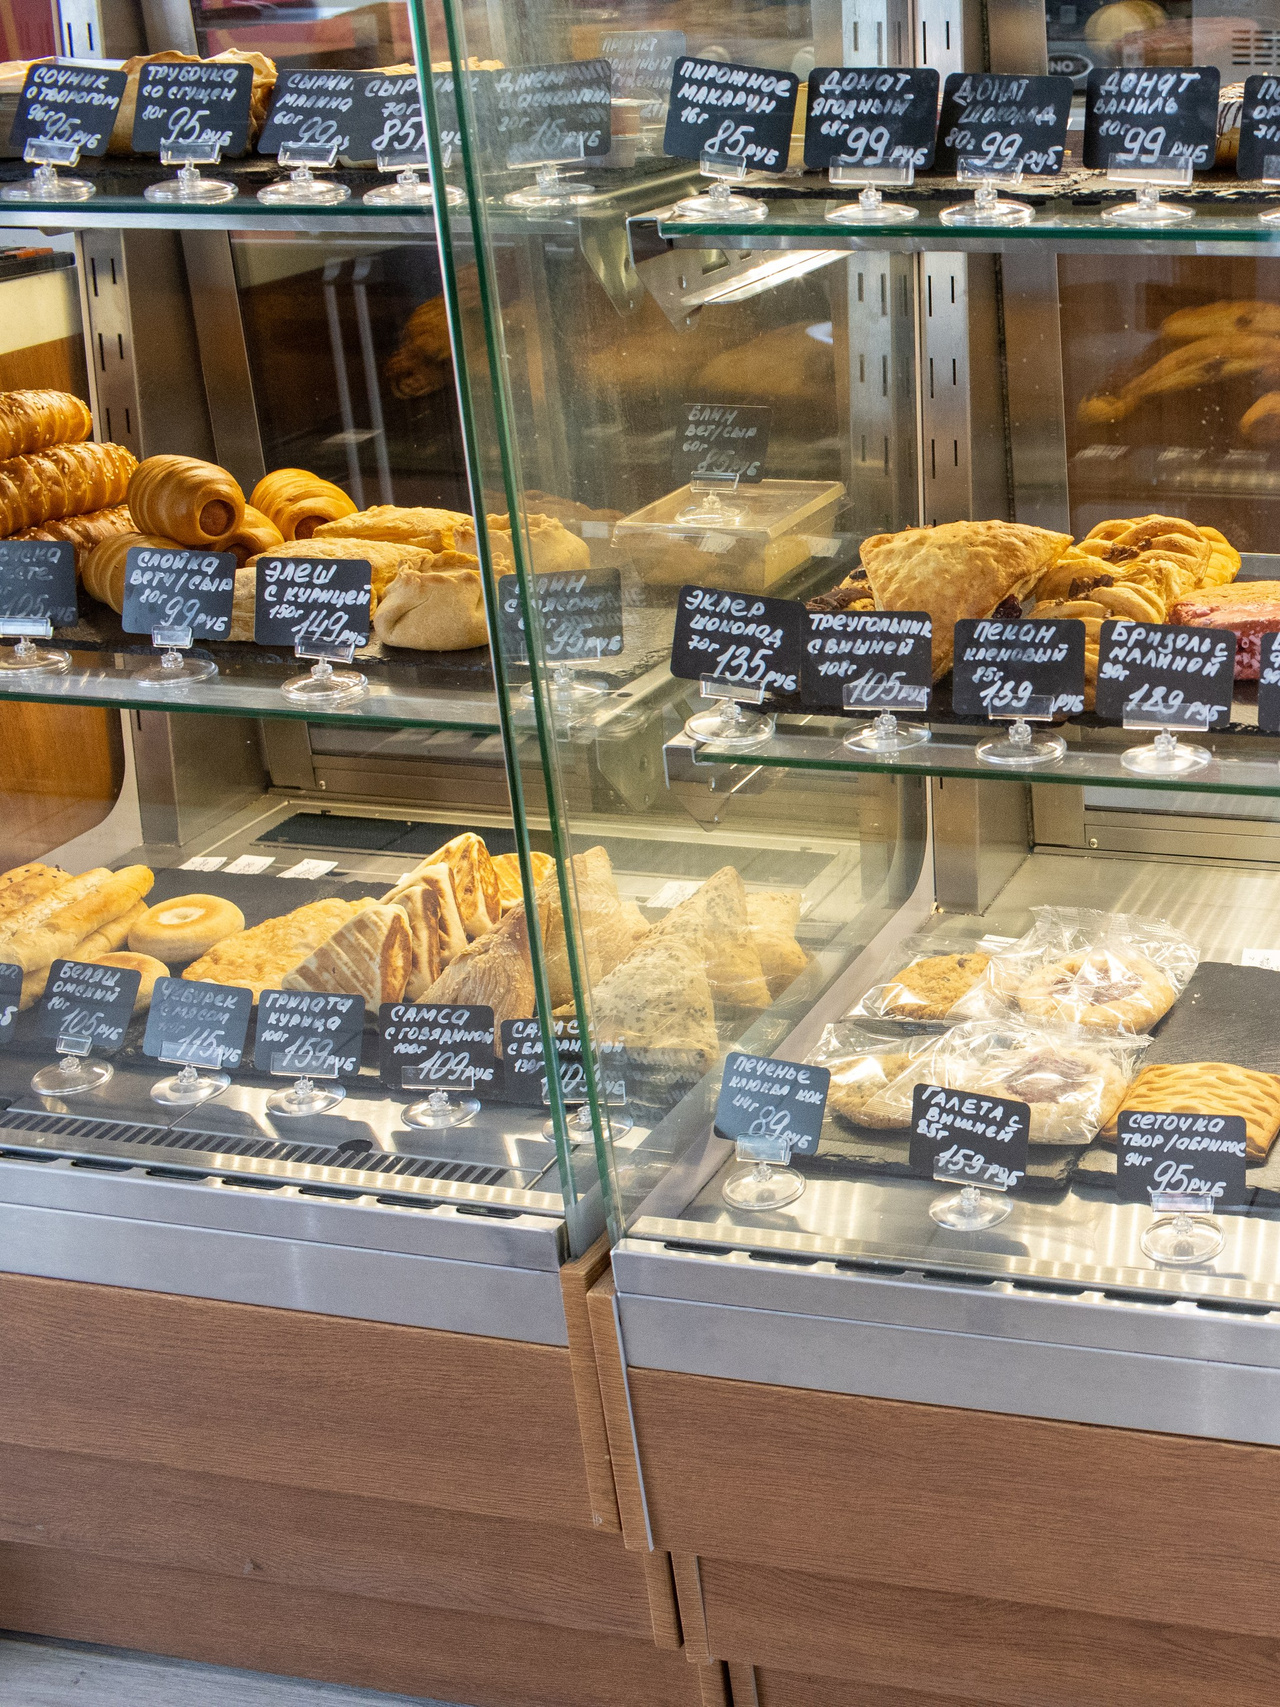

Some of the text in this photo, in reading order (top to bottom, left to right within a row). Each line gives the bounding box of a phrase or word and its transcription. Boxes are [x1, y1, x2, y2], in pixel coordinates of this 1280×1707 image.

[33, 66, 110, 90] СОЧНИК
[148, 65, 240, 83] ТРУБОЧКА
[680, 61, 791, 98] ПИРОЖНОЕ
[820, 70, 911, 95] ДОНАТ
[1099, 71, 1201, 98] ДОНАТ
[39, 87, 120, 110] ТВОРОГОМ
[677, 83, 776, 114] МАКАРУН
[953, 75, 1030, 107] ДОНАТ
[811, 93, 915, 119] ЯГОДНЫЙ
[1093, 96, 1179, 115] ВАНИЛЬ
[704, 119, 755, 156] 85
[839, 126, 891, 166] 99
[968, 131, 1023, 169] 99
[1115, 126, 1167, 163] 99
[137, 551, 220, 575] СЛОЙКА
[264, 561, 338, 585] ЭЛЕШ
[283, 584, 372, 608] КУРИЦЕЙ
[685, 590, 765, 617] ЭКЛЕР
[291, 610, 349, 643] 149
[690, 613, 783, 648] ШОКОЛАД
[809, 613, 933, 639] ТРЕУГОЛЬНИК
[973, 621, 1057, 643] ПЕКАН
[824, 637, 915, 656] ВИШНЕЙ
[963, 644, 1069, 663] КЛЕНОВЫЙ
[713, 644, 774, 683] 135
[1108, 646, 1228, 677] МАЛИНОЙ
[844, 668, 907, 704] 105
[1126, 683, 1184, 714] 189
[390, 1005, 471, 1026] САМСА
[733, 1056, 811, 1084] ПЕЧЕНЬЕ
[922, 1085, 1005, 1121] ГАЛЕТА
[1129, 1113, 1226, 1133] СЕТОЧКА
[938, 1144, 985, 1175] 159
